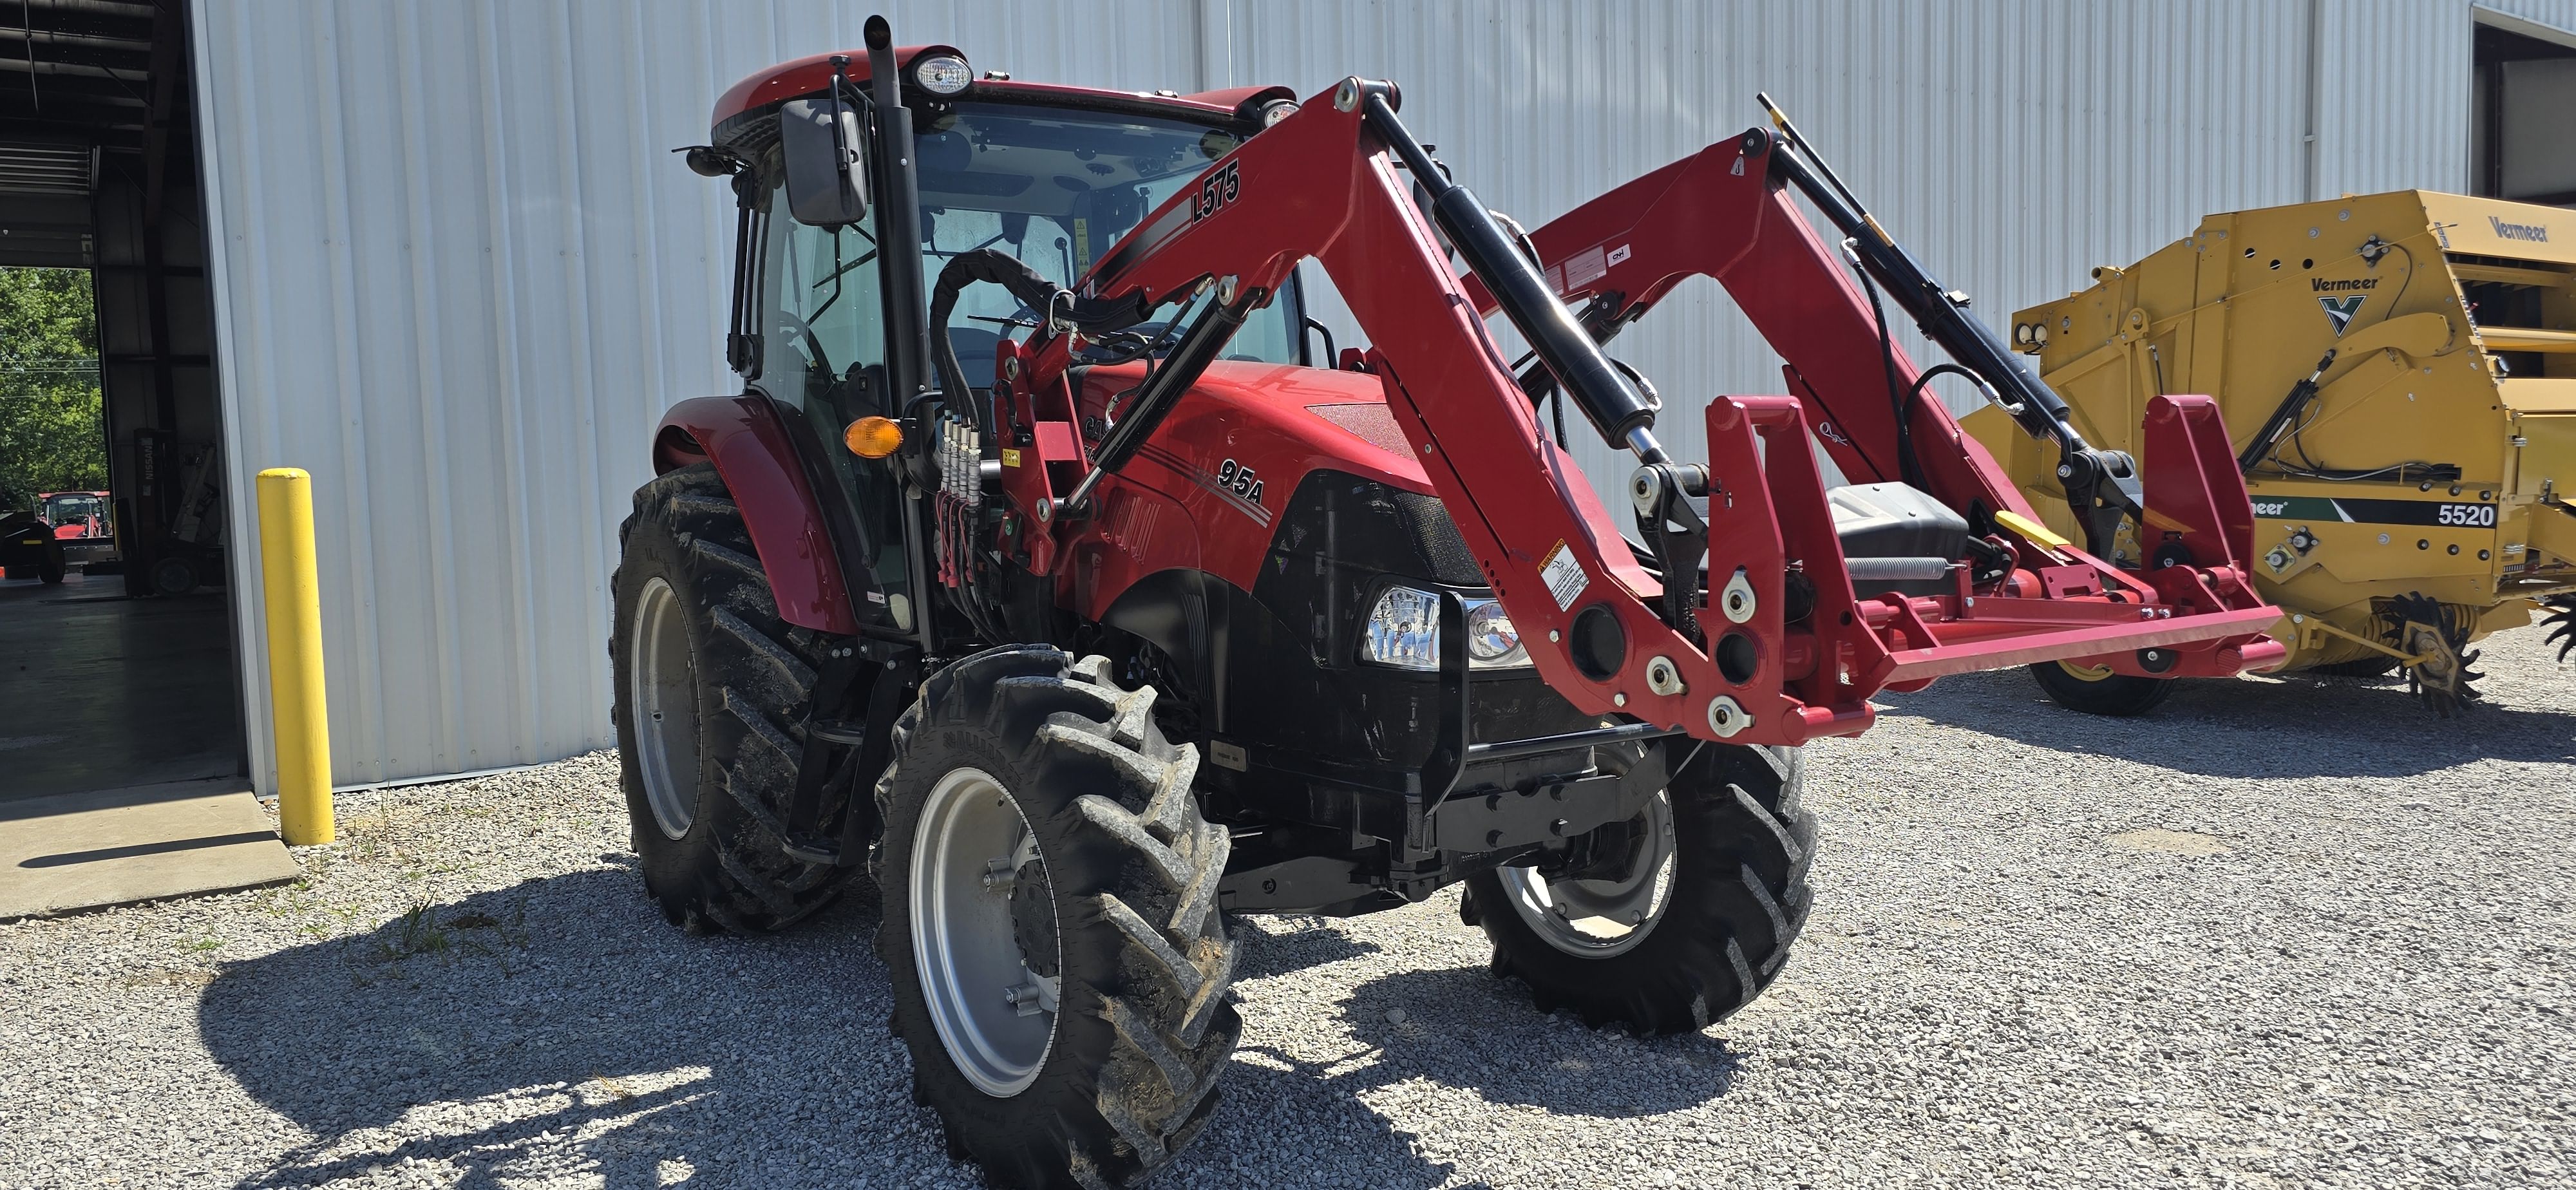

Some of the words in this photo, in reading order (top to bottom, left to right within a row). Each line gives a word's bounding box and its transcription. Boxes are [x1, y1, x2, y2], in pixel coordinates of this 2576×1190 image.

[1193, 157, 1240, 225] L575
[2488, 216, 2548, 243] Vermeer
[1613, 249, 1624, 260] CNH
[2311, 278, 2378, 291] Vermeer
[145, 445, 154, 480] NISSAN
[1217, 458, 1264, 505] 95A
[2438, 504, 2494, 526] 5520
[1542, 540, 1565, 567] WARNING
